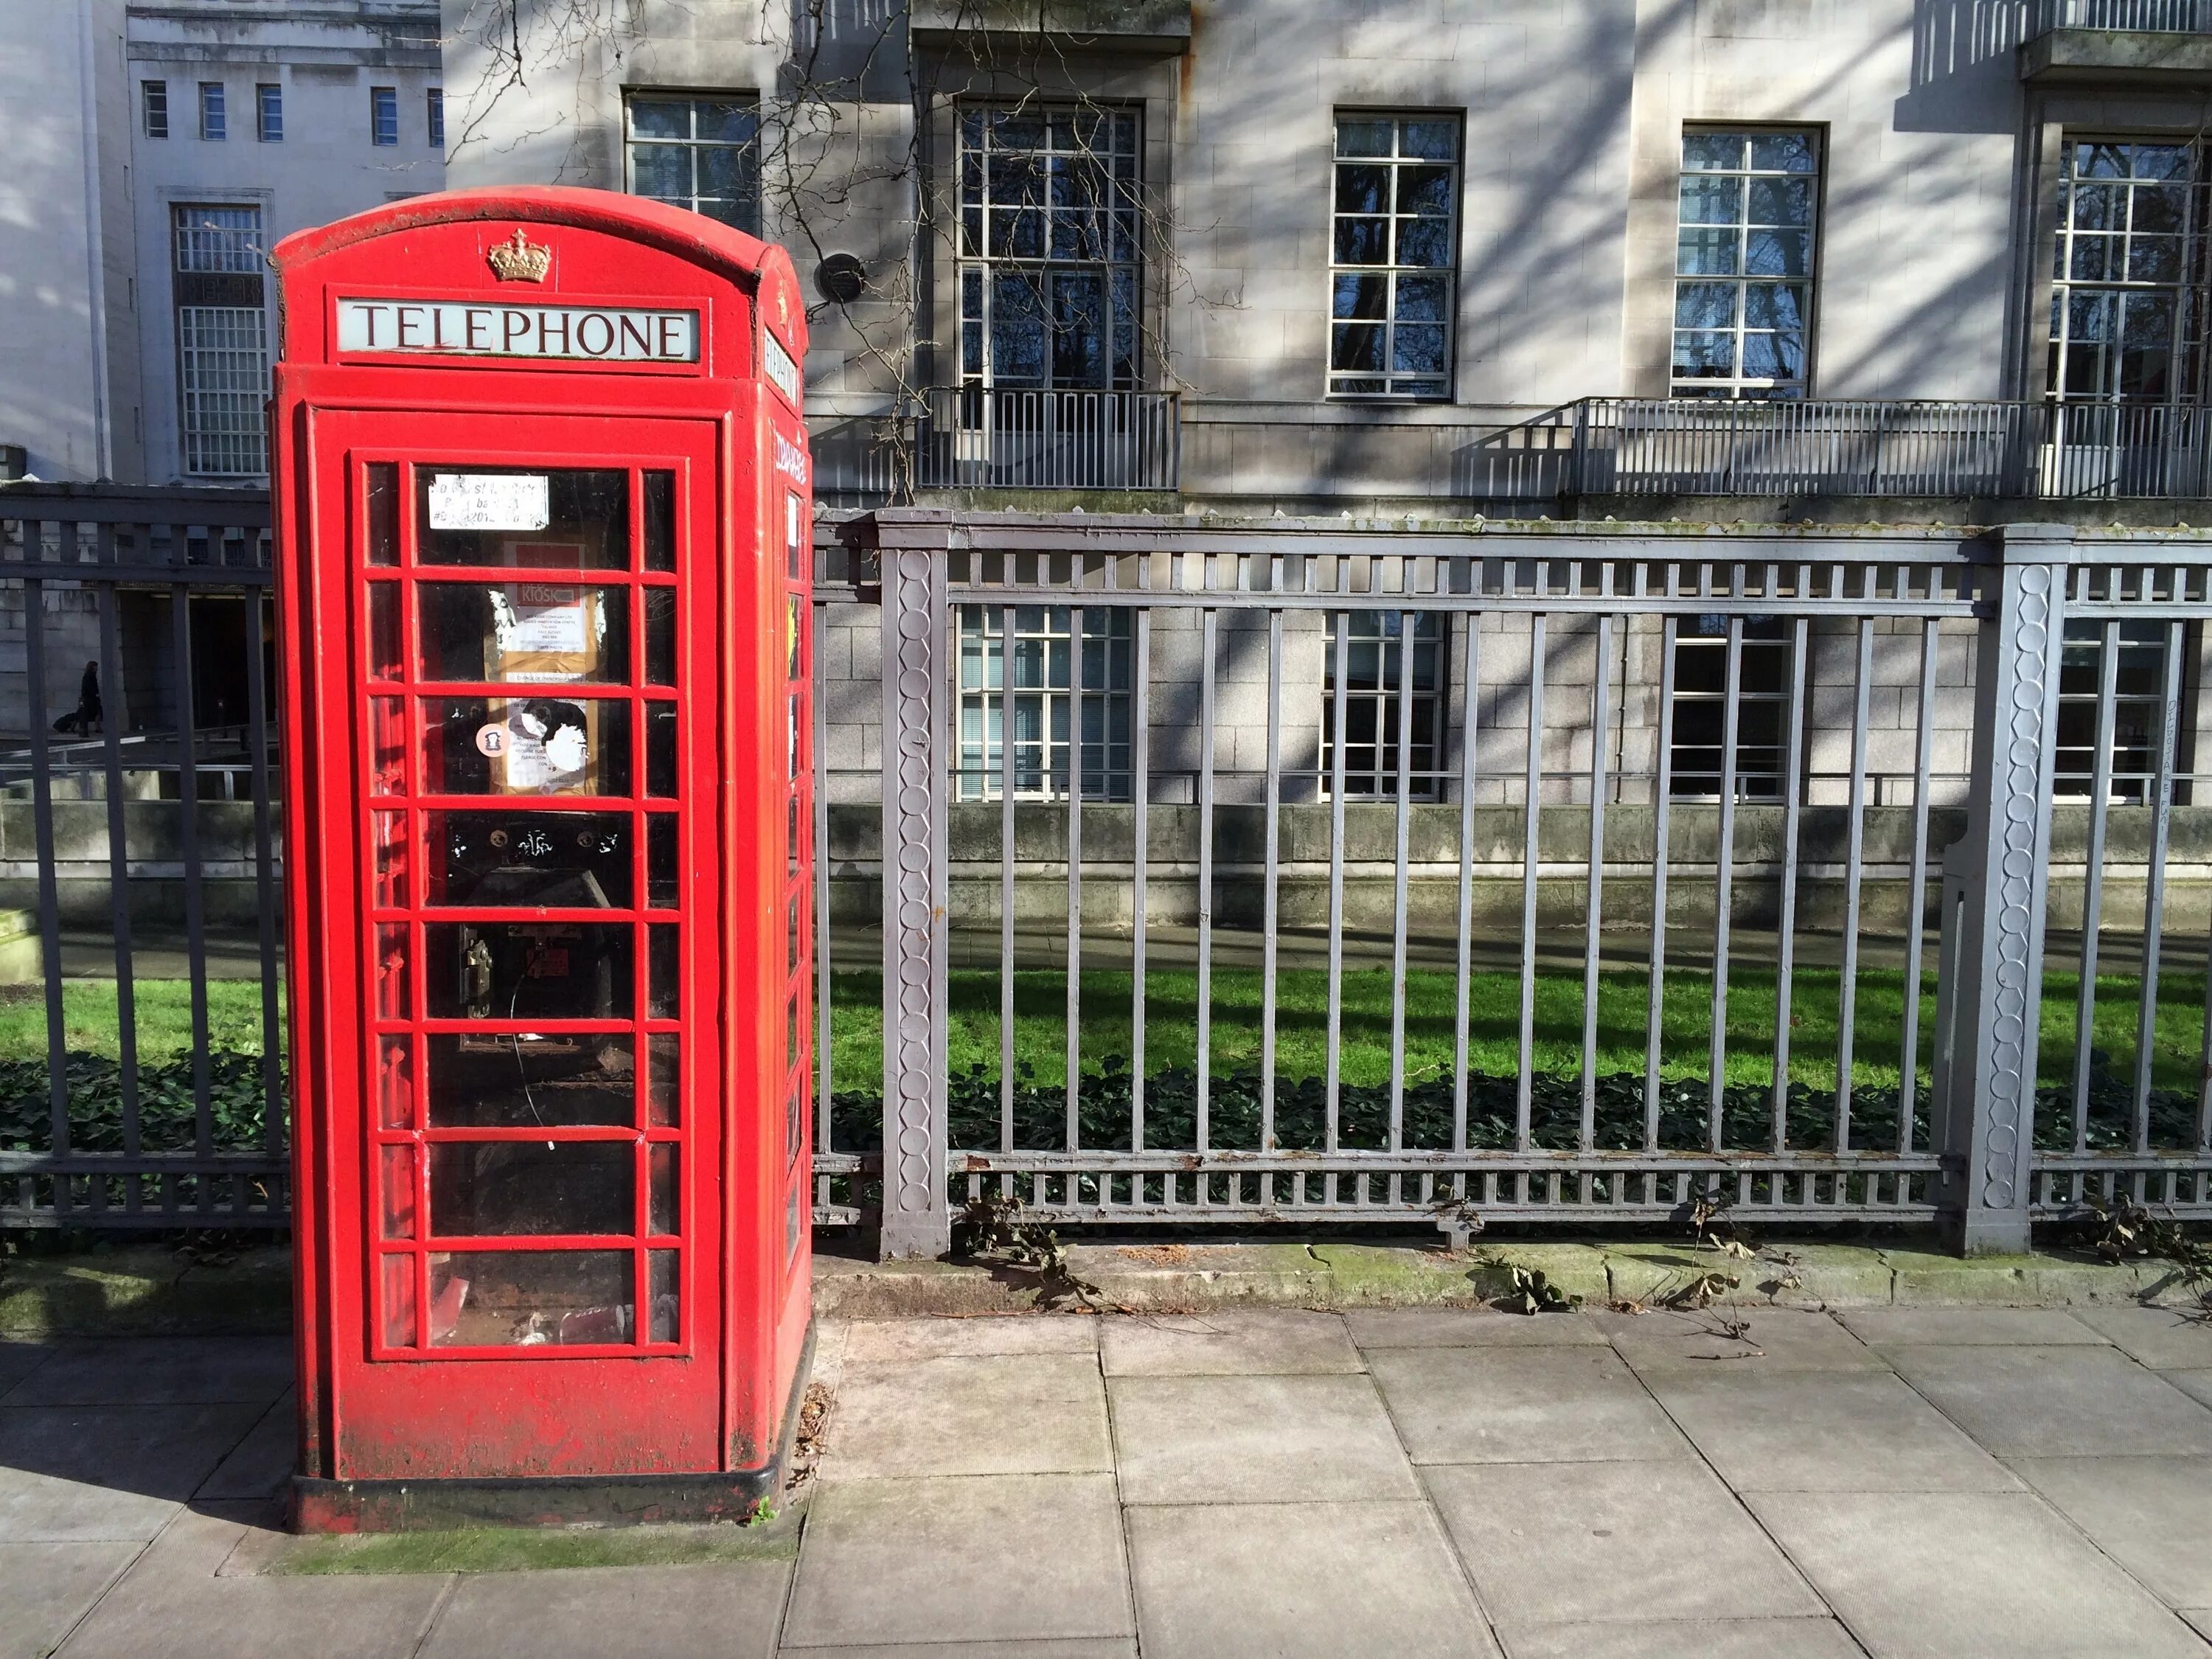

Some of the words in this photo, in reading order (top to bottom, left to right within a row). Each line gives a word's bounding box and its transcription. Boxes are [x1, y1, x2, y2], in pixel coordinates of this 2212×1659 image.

[352, 305, 684, 358] TELEPHONE
[766, 337, 795, 405] ELEPHONE
[2163, 762, 2171, 793] ARE
